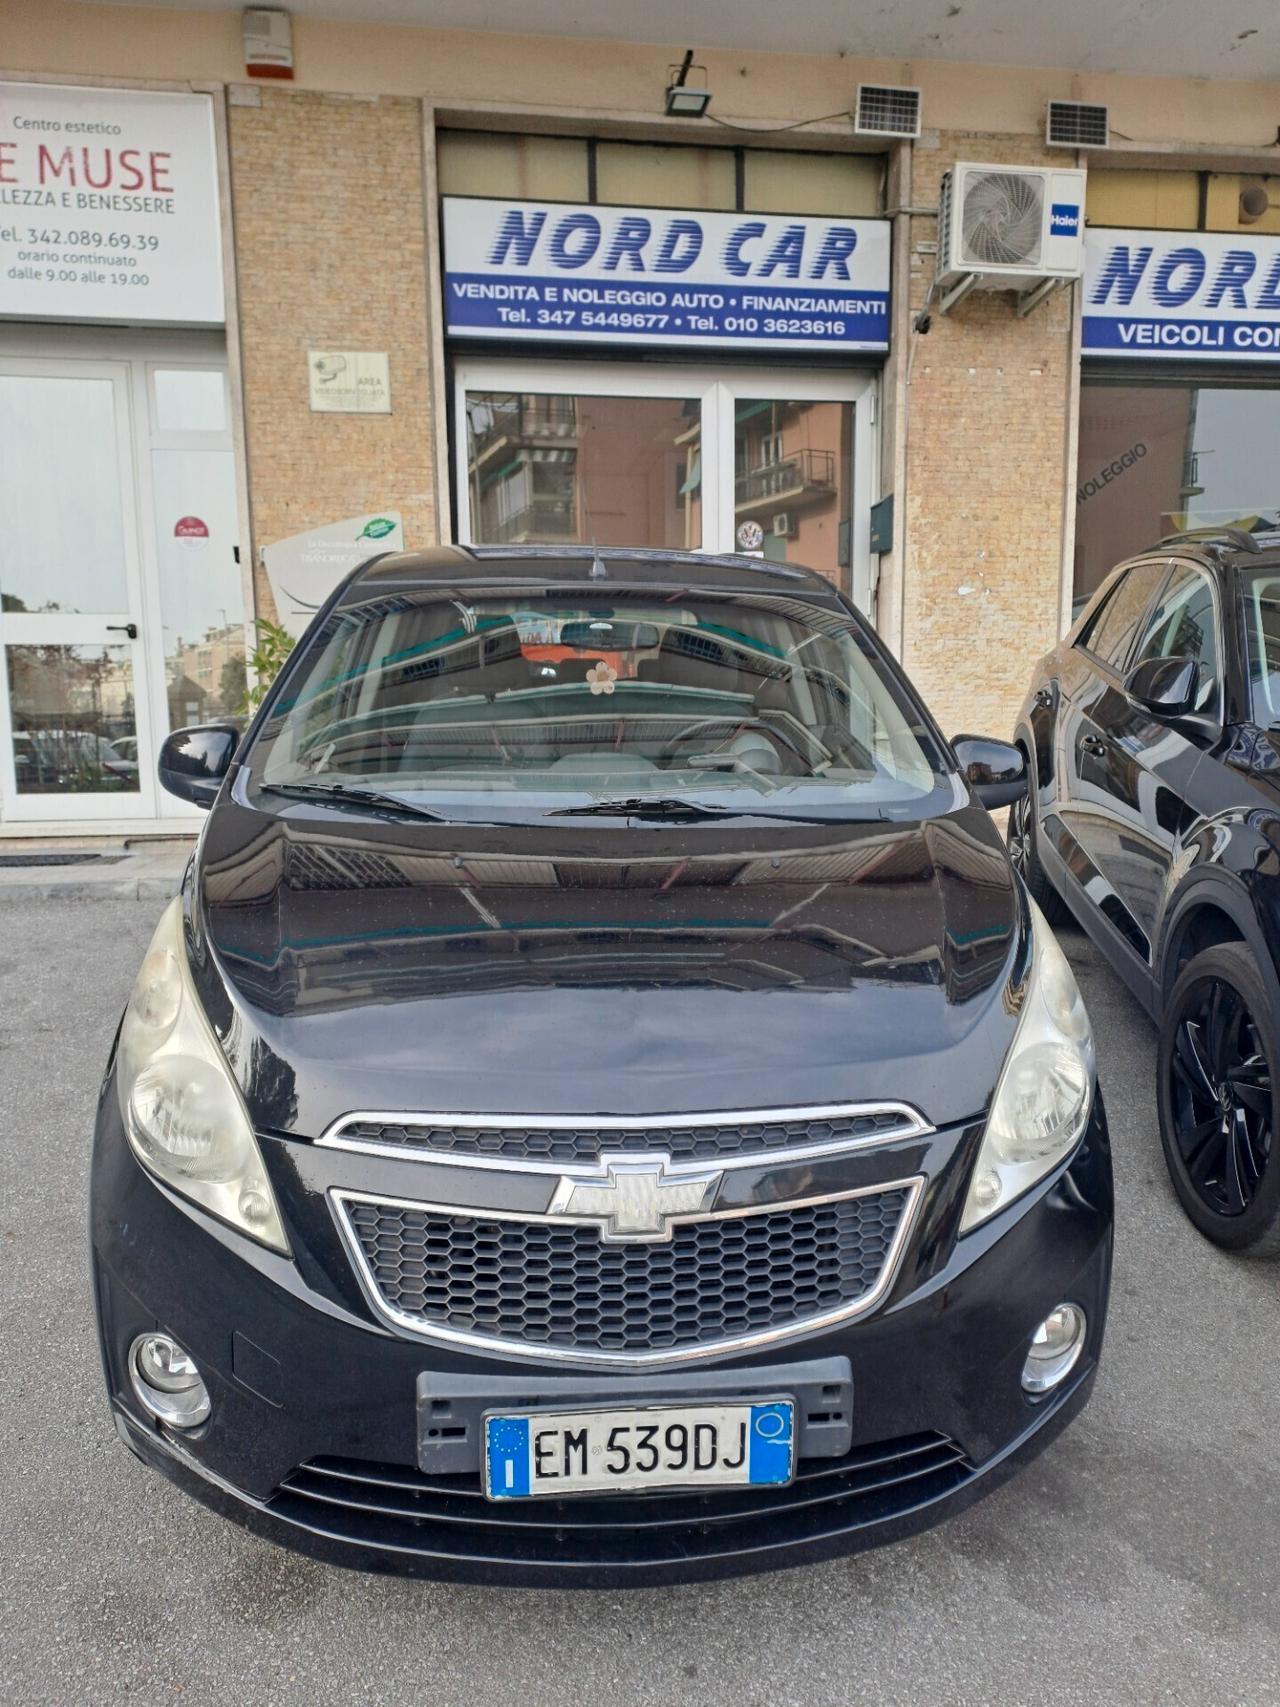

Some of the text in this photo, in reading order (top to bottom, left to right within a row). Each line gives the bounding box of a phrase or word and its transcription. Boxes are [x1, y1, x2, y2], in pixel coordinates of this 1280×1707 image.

[13, 116, 122, 135] Centro estetico
[38, 144, 174, 193] MUSE
[61, 193, 72, 208] E
[77, 193, 175, 214] BENESSERE
[1051, 214, 1079, 226] Haier
[28, 228, 160, 251] 342.089.69.39
[484, 210, 858, 281] NORD CAR
[18, 251, 137, 267] orario continuato
[7, 267, 150, 286] dalle 9.00 alle 19.00
[452, 283, 886, 315] VENDITA E NOLEGGIO AUTO FINANZIAMENTI
[497, 307, 846, 335] Tel. 347 5449677 Tel. 010 3623616
[1117, 323, 1225, 346] VEICOLI
[1076, 442, 1148, 505] NOLEGGIO
[534, 1422, 747, 1479] EM 539DJ
